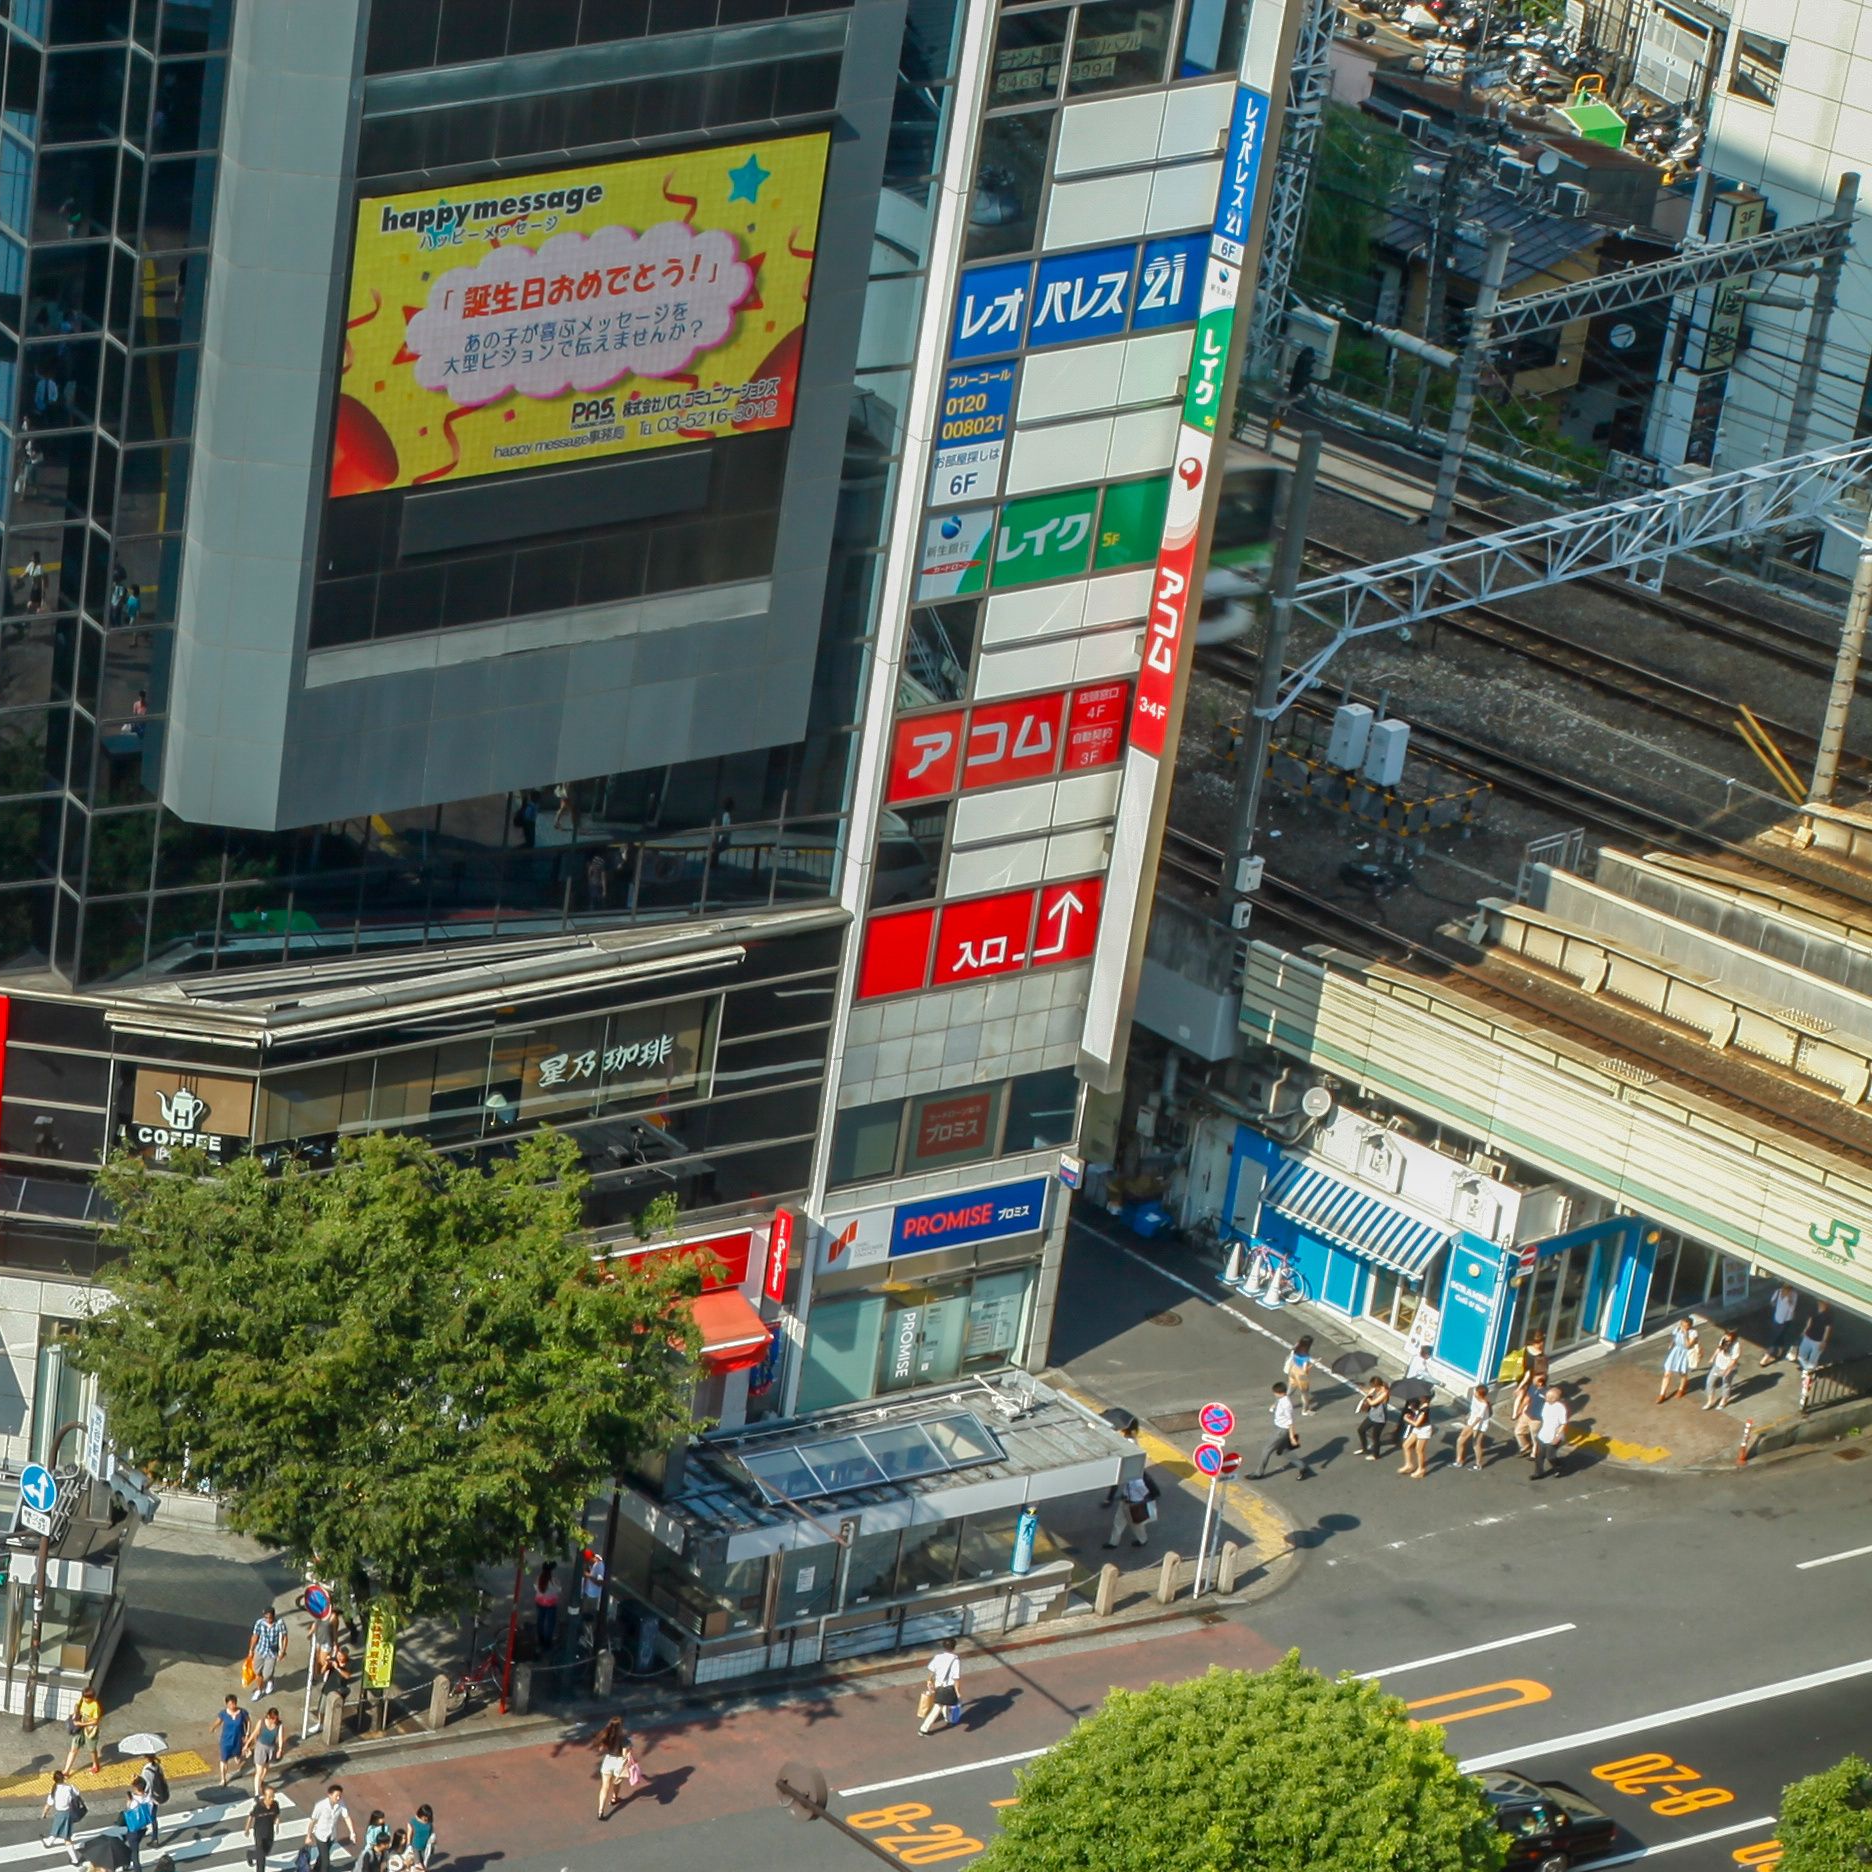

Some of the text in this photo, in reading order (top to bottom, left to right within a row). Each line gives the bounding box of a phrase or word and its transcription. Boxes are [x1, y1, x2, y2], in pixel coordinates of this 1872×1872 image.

[1224, 97, 1259, 237] レオパレス21
[420, 216, 559, 249] ハッピーメッセージ
[1220, 242, 1236, 257] 6F
[960, 253, 1187, 340] レオパレス21
[464, 302, 689, 353] あの子が喜ぶメッセージを
[443, 320, 704, 376] 大型ビジョンで伝えませんか？
[1195, 328, 1221, 405] レイク
[948, 368, 1011, 389] フリーコール
[946, 393, 987, 416] 0120
[942, 415, 1004, 440] 008021
[934, 447, 1000, 469] お部屋探しは
[949, 472, 978, 496] 6F
[996, 512, 1092, 562] レイク
[1102, 532, 1121, 547] 5F
[1147, 568, 1186, 675] アコム
[1086, 704, 1106, 719] 4F
[908, 714, 1053, 780] アコム
[1079, 750, 1099, 765] 3F
[952, 935, 1008, 972] 入口
[538, 1034, 675, 1088] 星乃珈琲
[926, 1119, 979, 1144] プロミス
[903, 1203, 1030, 1239] PROMISE プロミス
[1809, 1218, 1861, 1260] JR
[895, 1312, 917, 1378] PROMISE
[845, 1802, 985, 1867] 8-20
